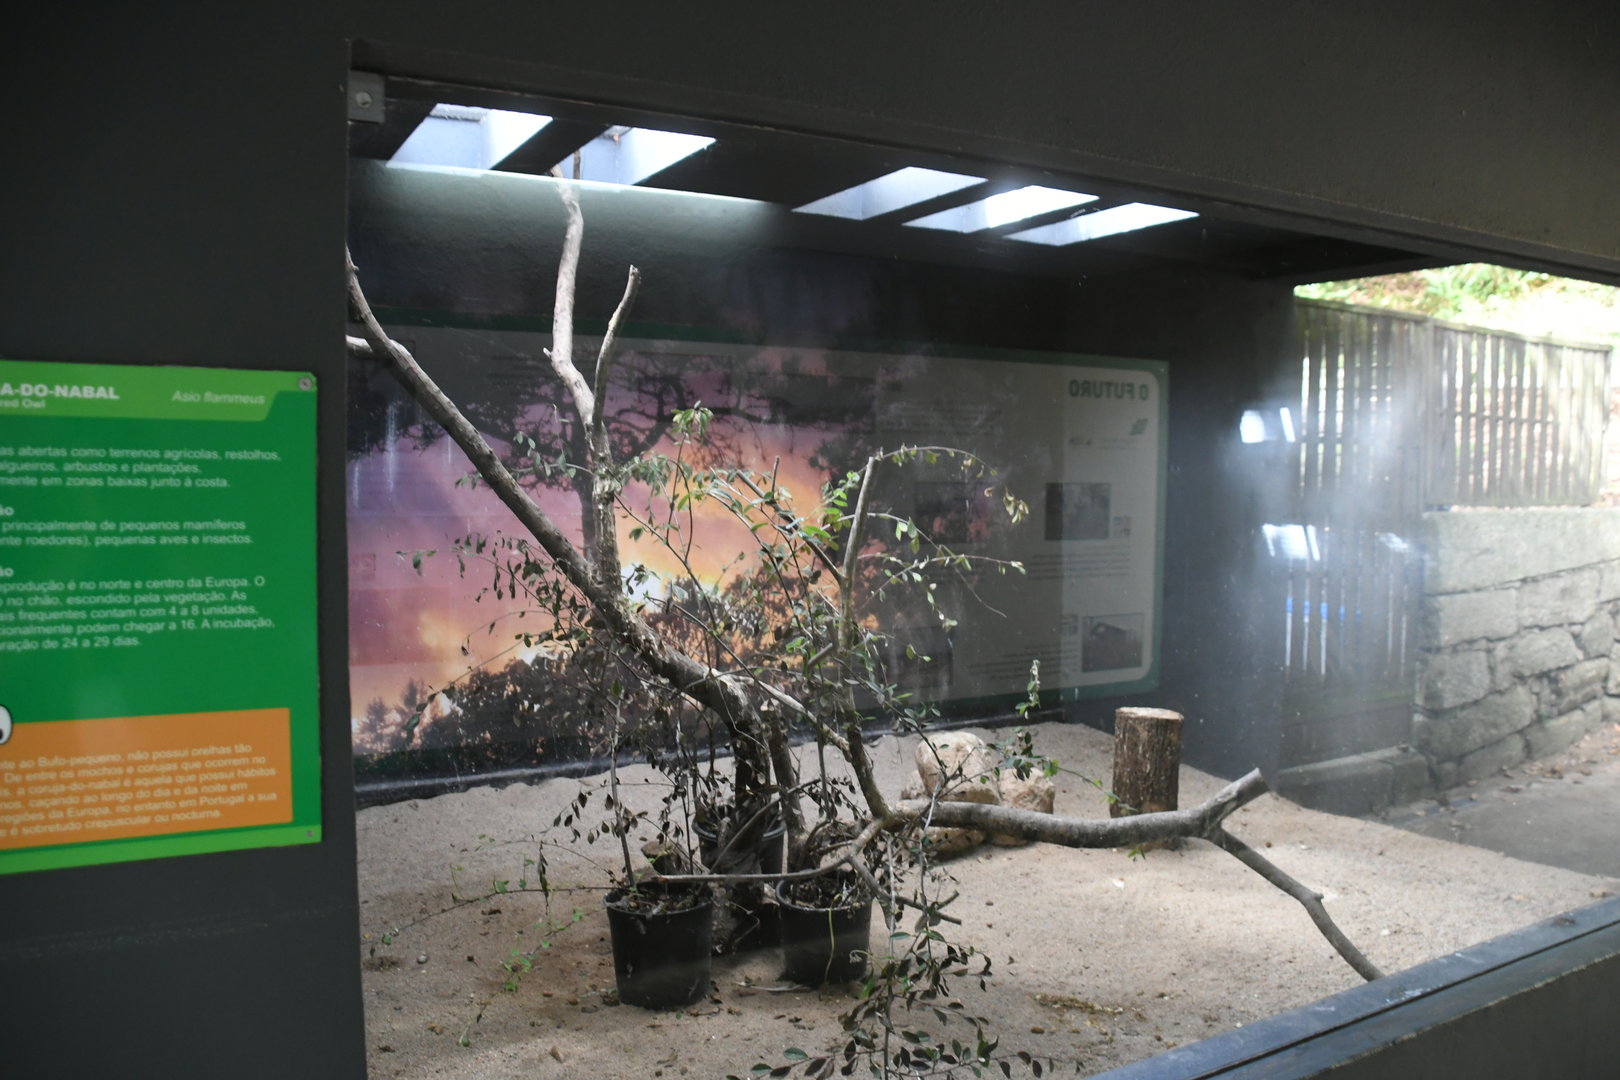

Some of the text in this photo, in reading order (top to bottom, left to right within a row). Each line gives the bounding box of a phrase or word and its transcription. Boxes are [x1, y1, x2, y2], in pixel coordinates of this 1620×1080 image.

[0, 383, 121, 400] A-DO-NABAL
[18, 445, 68, 457] abertas
[70, 448, 106, 458] como
[109, 447, 161, 458] terrenos
[63, 461, 119, 472] arbustos
[120, 463, 130, 472] e
[41, 477, 63, 486] em
[65, 477, 104, 487] zonas
[107, 476, 148, 487] baixas
[150, 477, 181, 490] junto
[100, 520, 117, 531] de
[119, 521, 181, 533] pequenos
[94, 535, 157, 547] pequenas
[159, 535, 189, 545] aves
[191, 535, 200, 544] e
[80, 581, 97, 590] no
[99, 579, 132, 590] norte
[134, 580, 143, 589] e
[145, 578, 185, 589] centro
[186, 577, 203, 588] da
[254, 575, 265, 587] O
[6, 597, 24, 606] no
[66, 593, 132, 605] escondido
[133, 593, 161, 605] pela
[231, 590, 247, 601] As
[18, 609, 88, 622] frequentes
[90, 608, 137, 619] contam
[139, 607, 166, 617] com
[169, 606, 177, 616] 4
[180, 607, 188, 616] a
[191, 605, 199, 616] 8
[76, 622, 121, 635] podem
[122, 620, 165, 634] chegar
[168, 621, 177, 630] a
[201, 618, 210, 629] A
[41, 637, 59, 649] de
[61, 636, 79, 648] 24
[81, 638, 91, 647] a
[93, 635, 111, 647] 29
[18, 759, 36, 769] ao
[127, 751, 150, 761] não
[152, 748, 189, 761] possui
[234, 743, 252, 754] tão
[60, 770, 75, 779] os
[126, 765, 135, 775] e
[180, 760, 202, 772] que
[251, 756, 266, 765] no
[175, 772, 197, 784] que
[199, 769, 235, 783] possui
[83, 794, 98, 803] ao
[100, 792, 133, 803] longo
[136, 789, 151, 799] do
[153, 787, 171, 798] dia
[173, 787, 181, 796] e
[183, 785, 198, 795] da
[230, 782, 248, 792] em
[47, 809, 64, 819] da
[115, 804, 131, 813] no
[178, 798, 197, 809] em
[199, 793, 245, 806] Portugal
[247, 794, 255, 803] a
[257, 792, 277, 802] sua
[154, 814, 169, 823] ou
